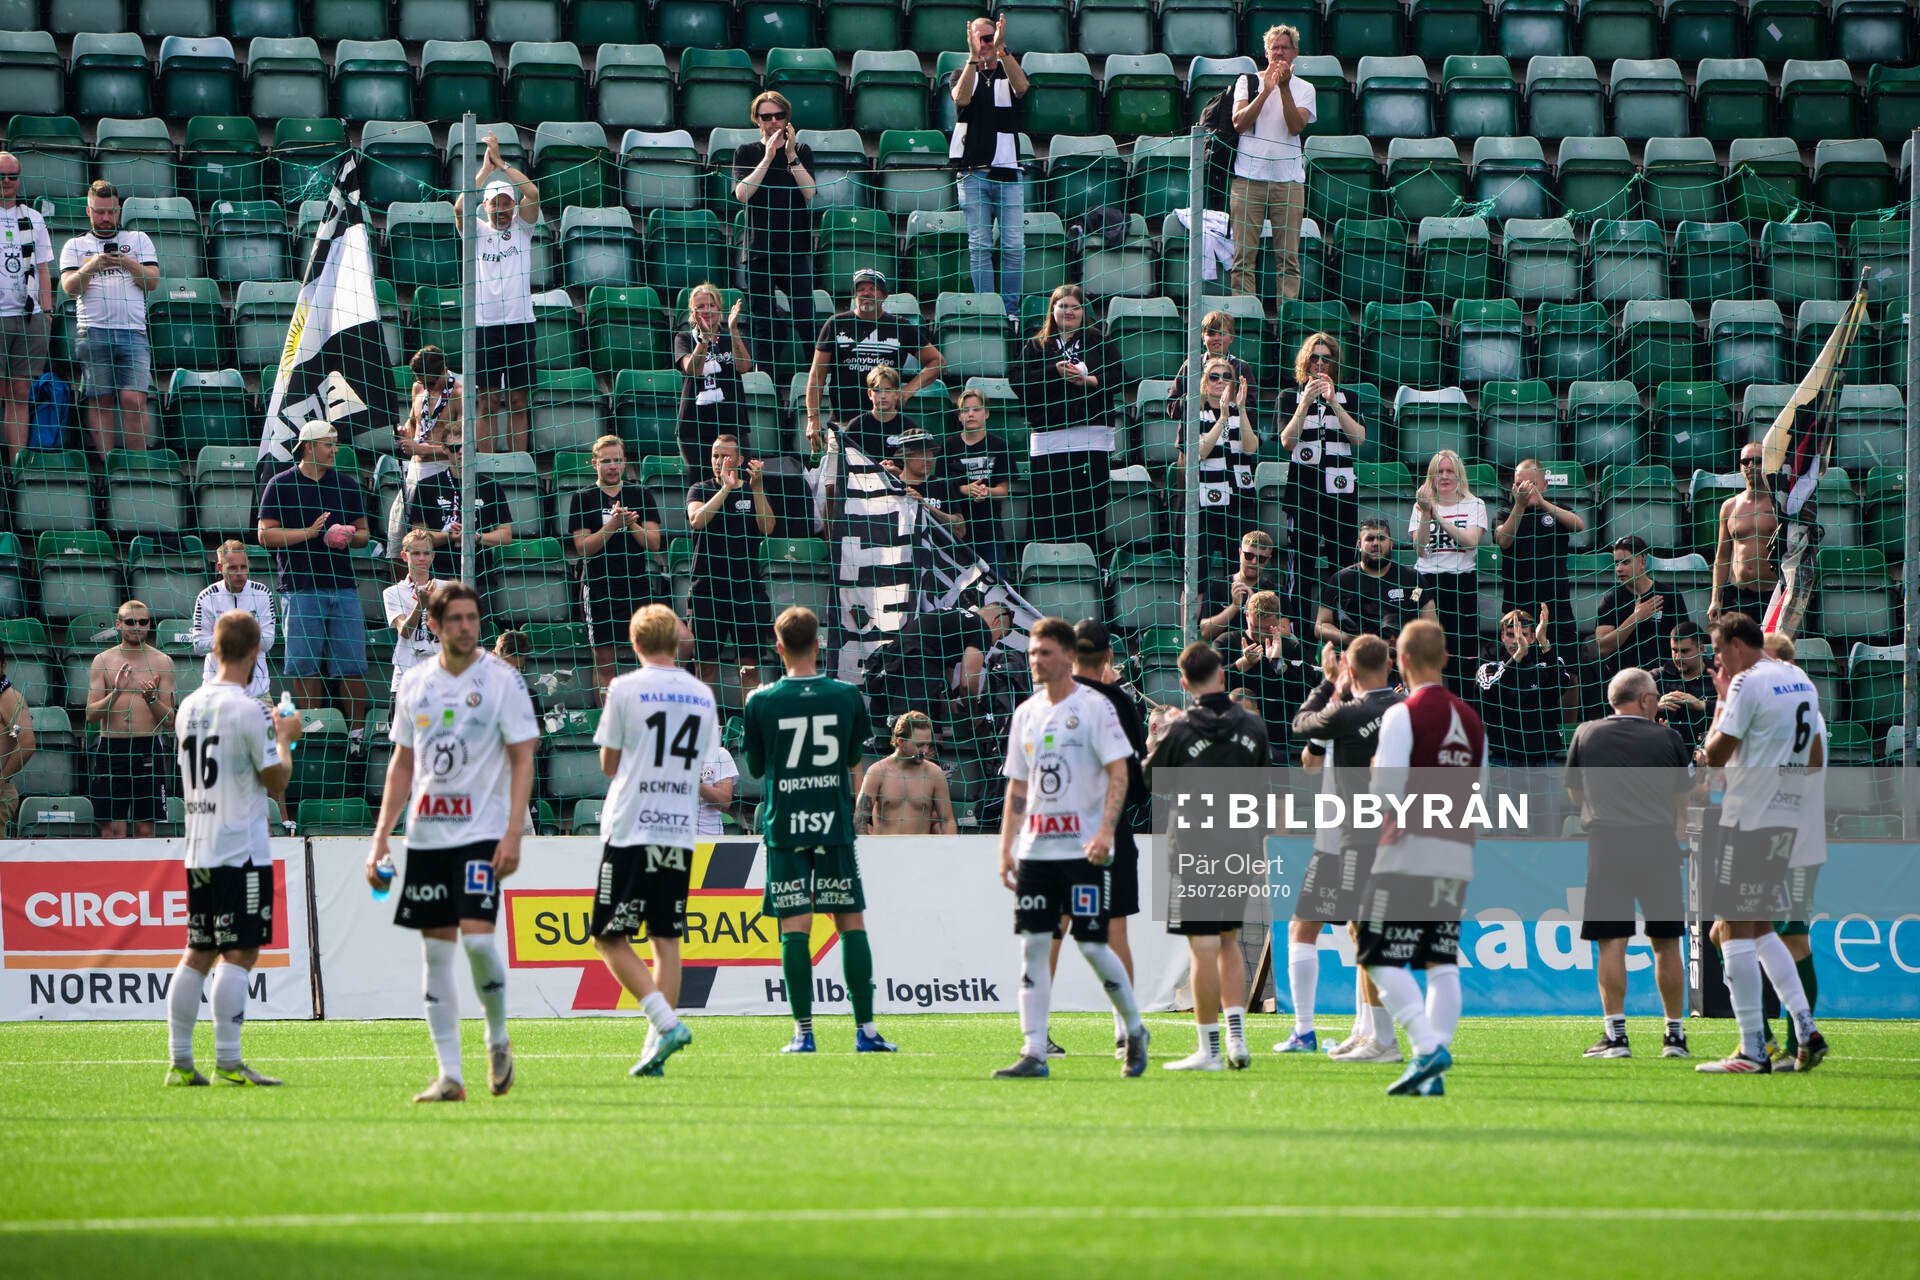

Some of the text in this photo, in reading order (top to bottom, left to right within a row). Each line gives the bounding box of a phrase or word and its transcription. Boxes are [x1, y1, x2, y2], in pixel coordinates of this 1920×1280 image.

[645, 711, 701, 770] 14
[778, 714, 840, 769] 75
[1793, 701, 1811, 754] 6
[182, 735, 219, 790] 16
[415, 794, 473, 817] MAXI
[790, 810, 835, 835] itsy
[771, 878, 806, 894] EXACT
[817, 878, 853, 891] EXACT
[25, 891, 187, 928] CIRCLE
[535, 911, 783, 945] SURAK
[31, 972, 267, 1004] NORRMM
[887, 977, 1000, 1007] logistik
